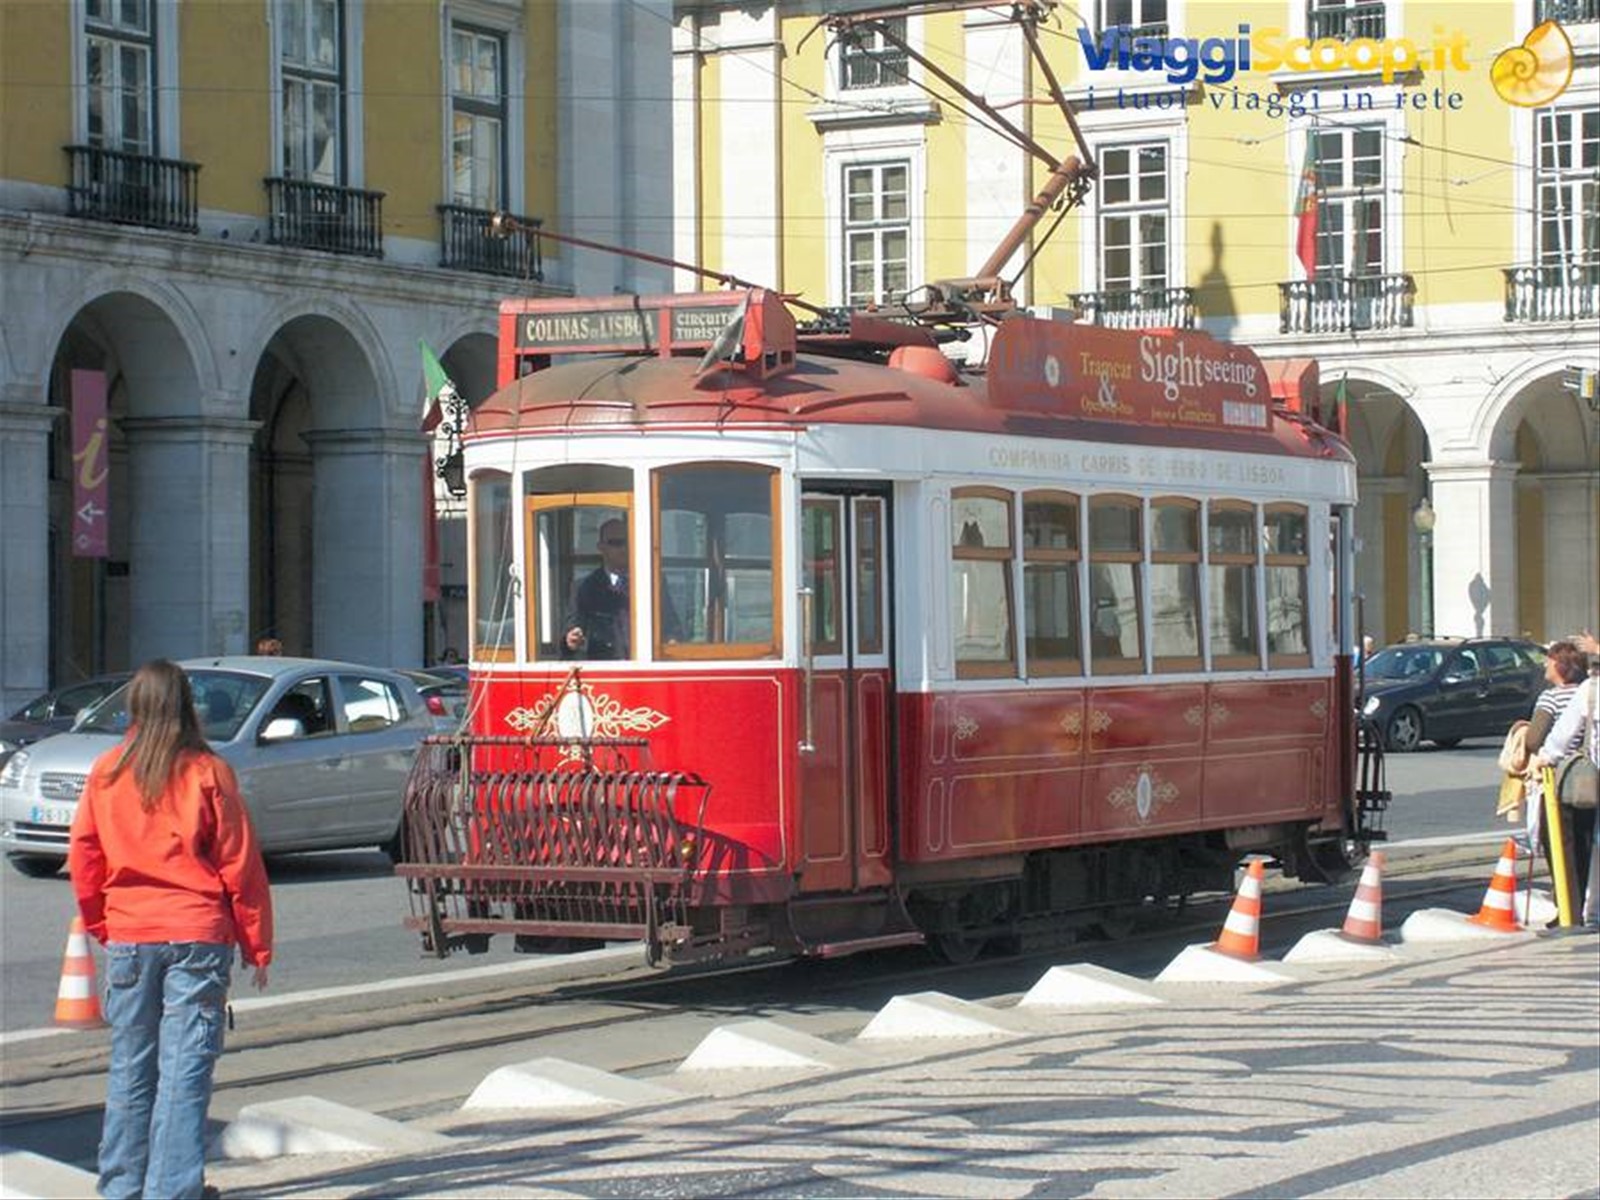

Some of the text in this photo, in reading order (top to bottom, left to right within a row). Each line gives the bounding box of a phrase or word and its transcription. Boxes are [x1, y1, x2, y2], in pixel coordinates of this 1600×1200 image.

[526, 316, 589, 341] COLINAS
[1140, 335, 1257, 401] Sightseeing
[1098, 368, 1117, 409] &
[1081, 453, 1132, 474] CARRIS
